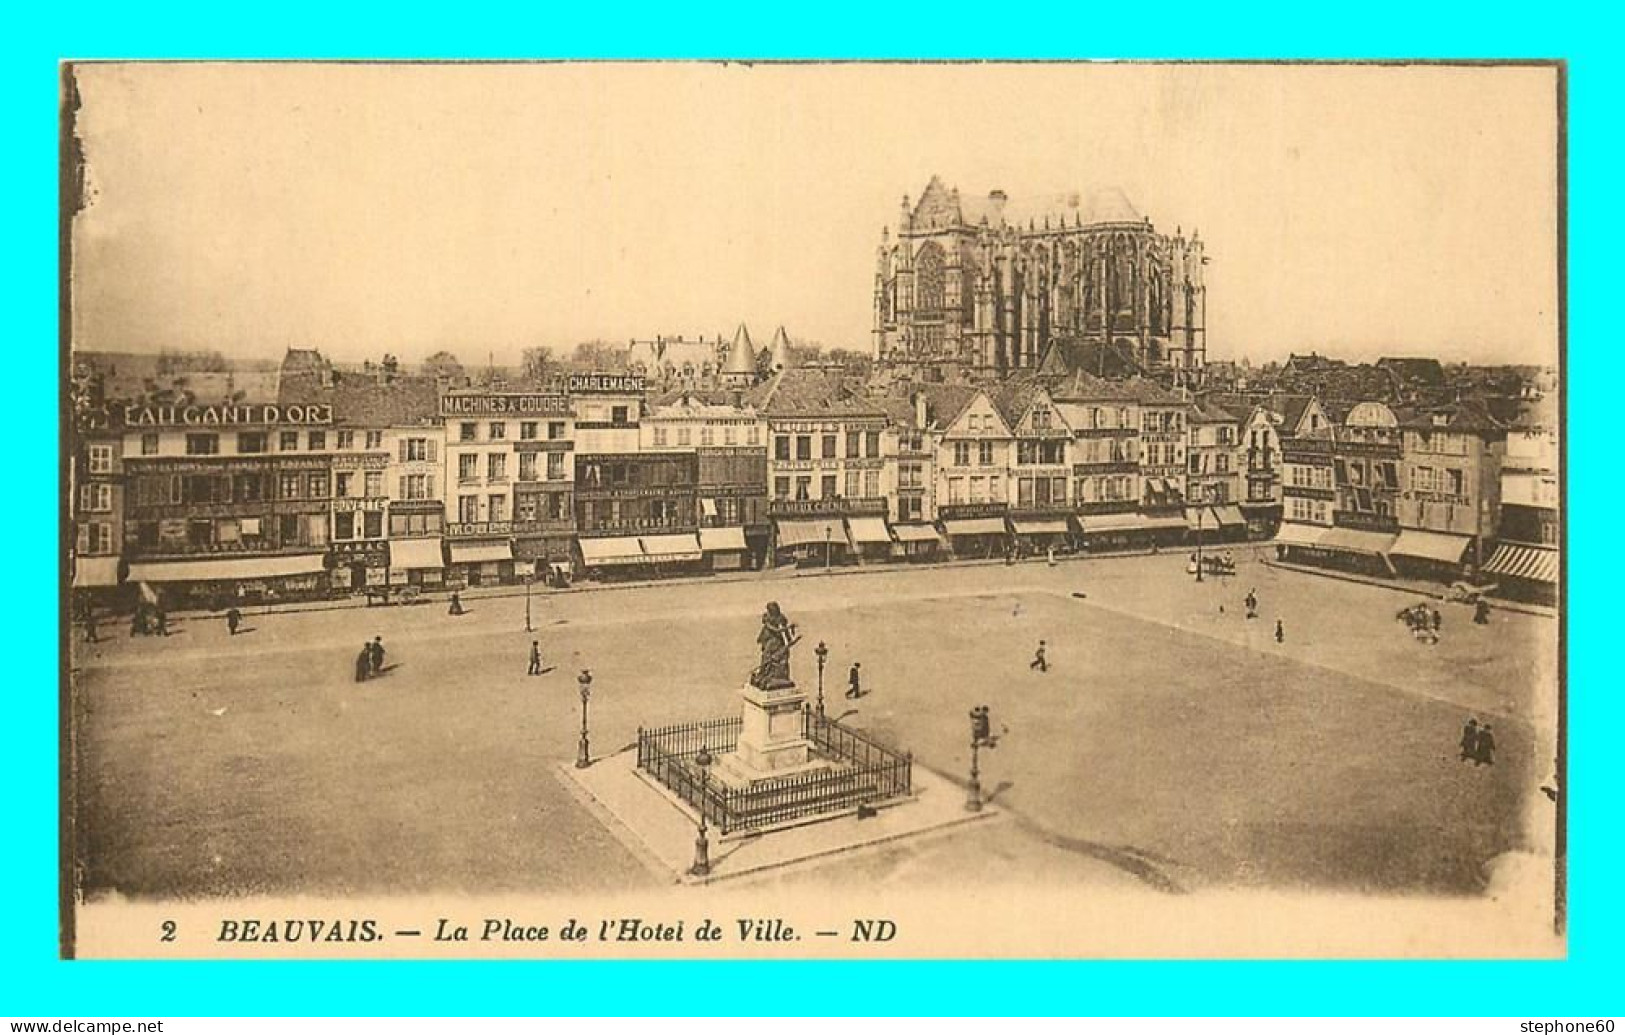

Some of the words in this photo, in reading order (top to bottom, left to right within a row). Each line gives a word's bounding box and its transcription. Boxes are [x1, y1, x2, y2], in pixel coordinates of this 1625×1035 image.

[570, 376, 645, 391] CHARLEMAGNE
[444, 396, 506, 413] MACHINES
[519, 396, 567, 413] COUDRE
[183, 404, 255, 426] GANT
